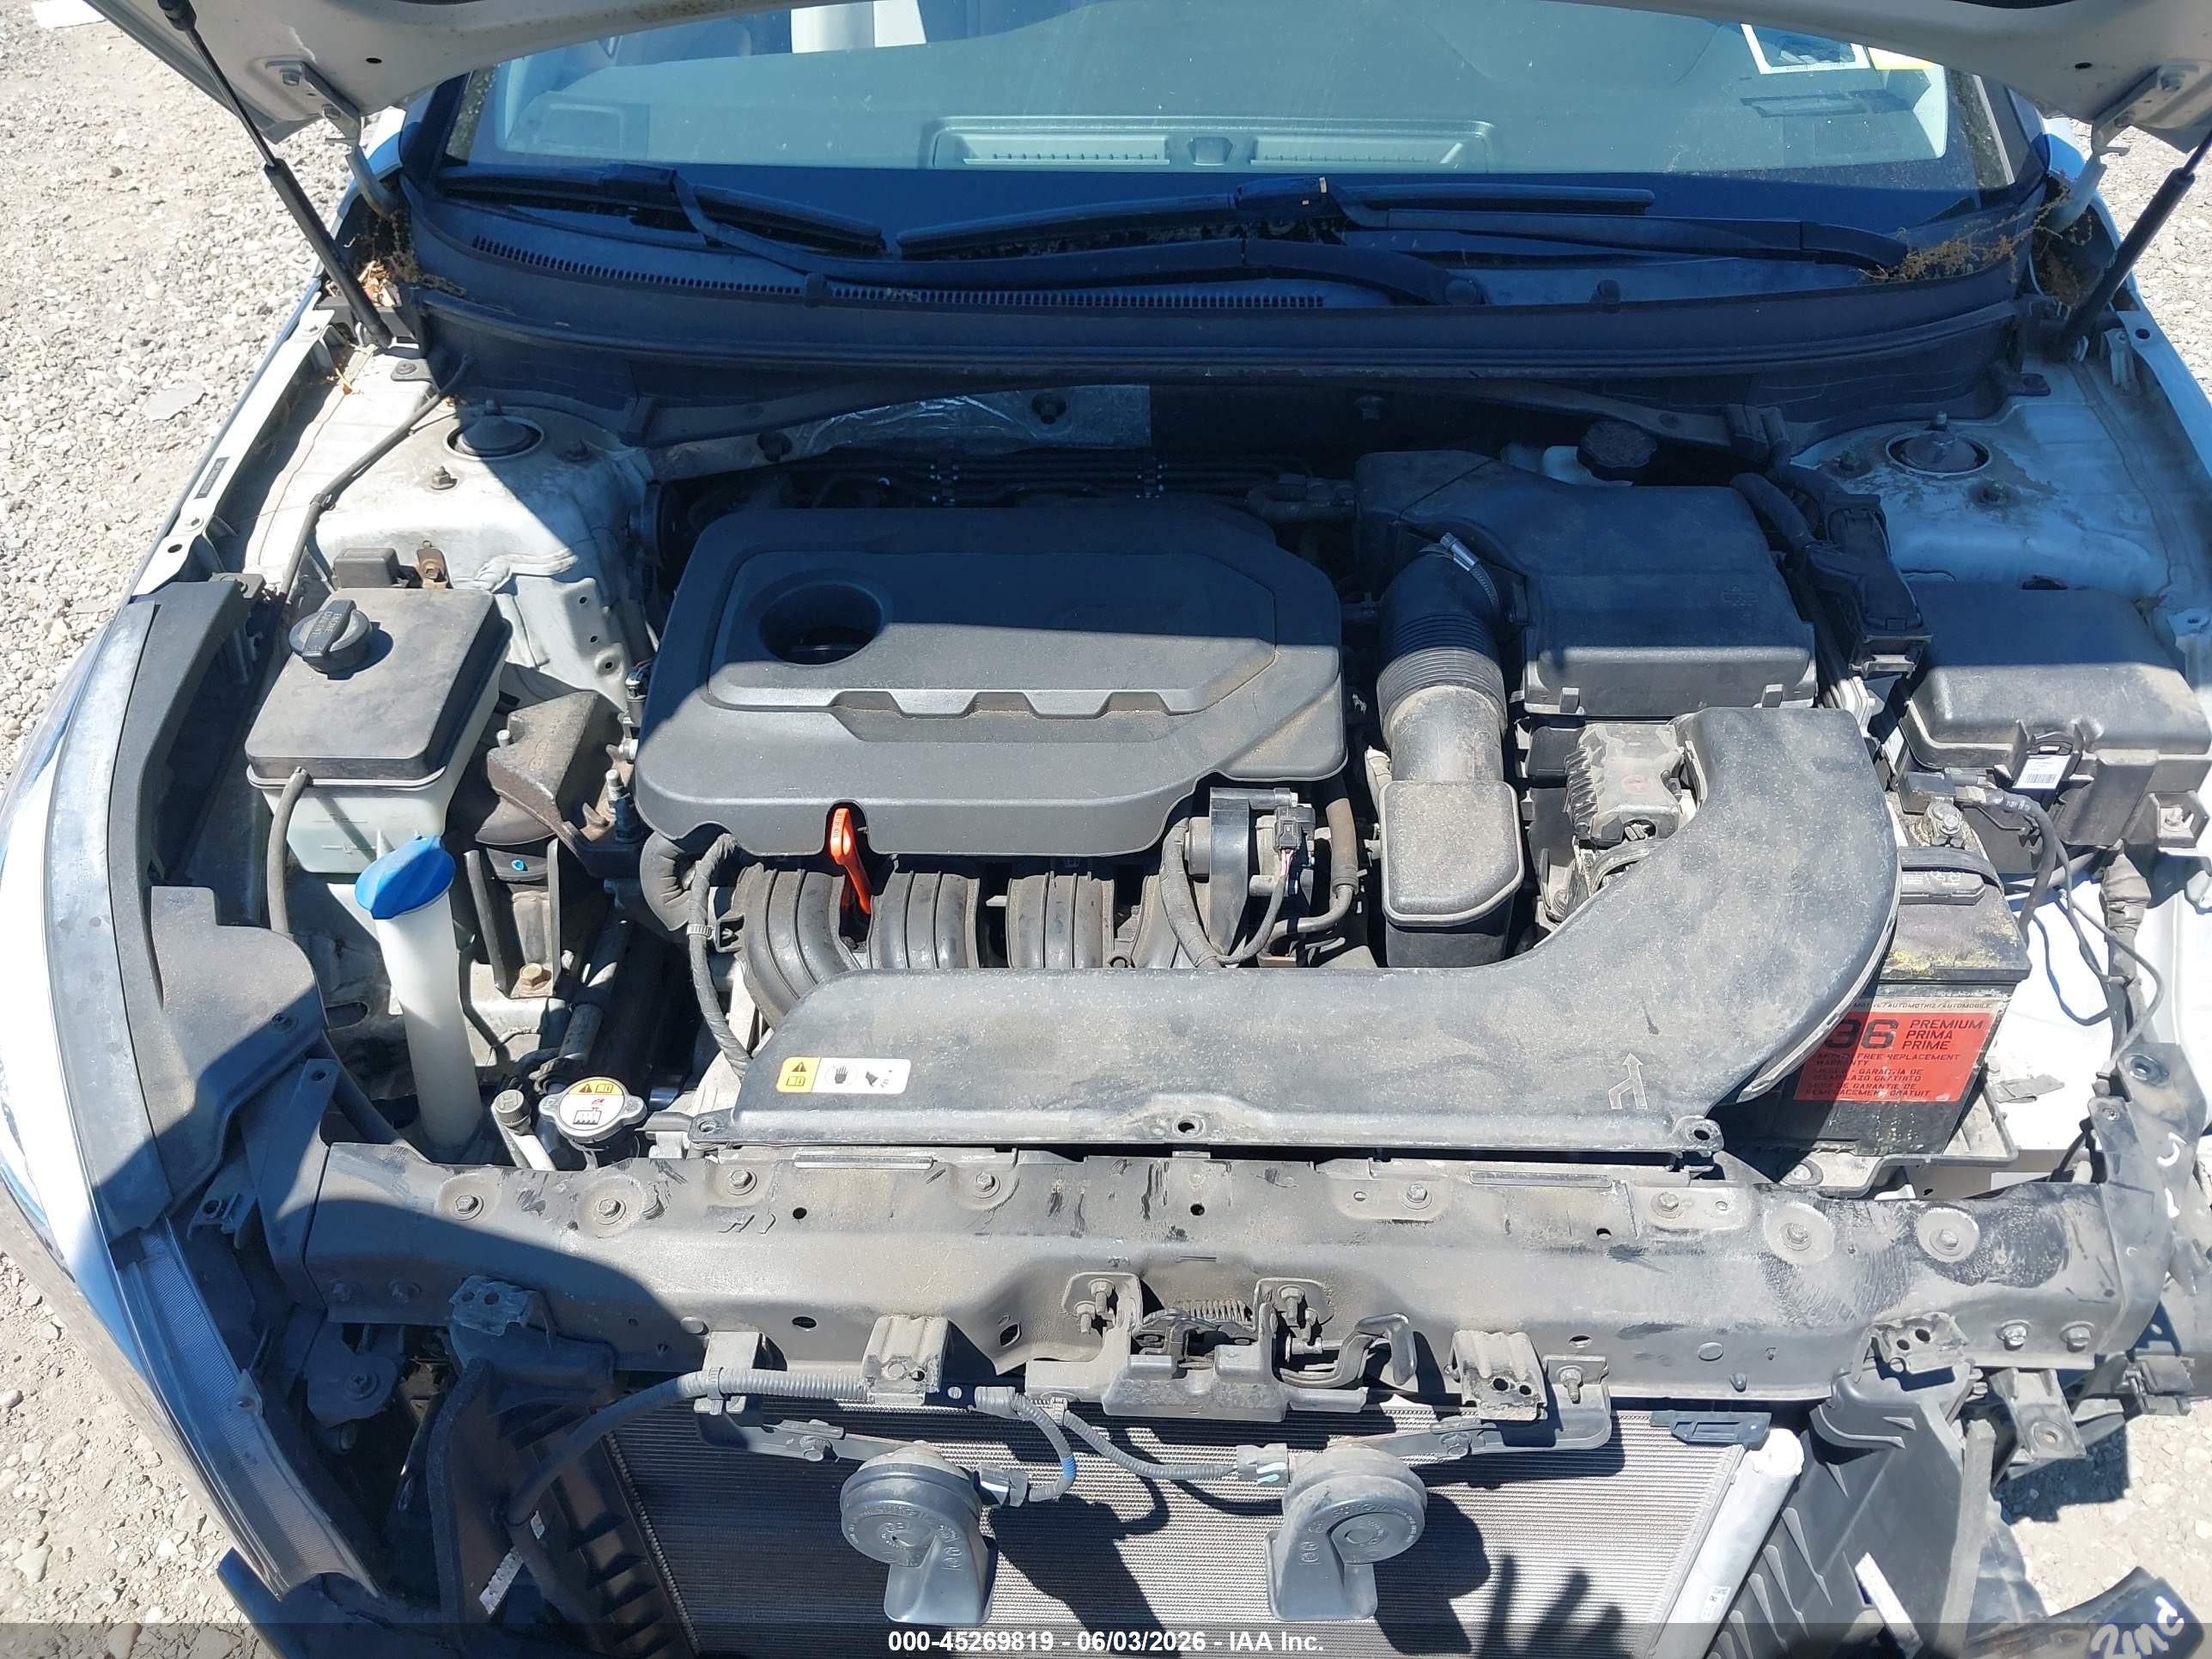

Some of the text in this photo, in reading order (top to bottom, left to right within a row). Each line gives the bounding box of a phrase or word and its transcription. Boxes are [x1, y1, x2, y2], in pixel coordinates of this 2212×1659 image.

[1910, 1019, 1984, 1030] PREMIUM
[1824, 1018, 1899, 1049] 36
[1905, 1030, 1953, 1040] PRIMA
[1901, 1040, 1951, 1050] PRIME
